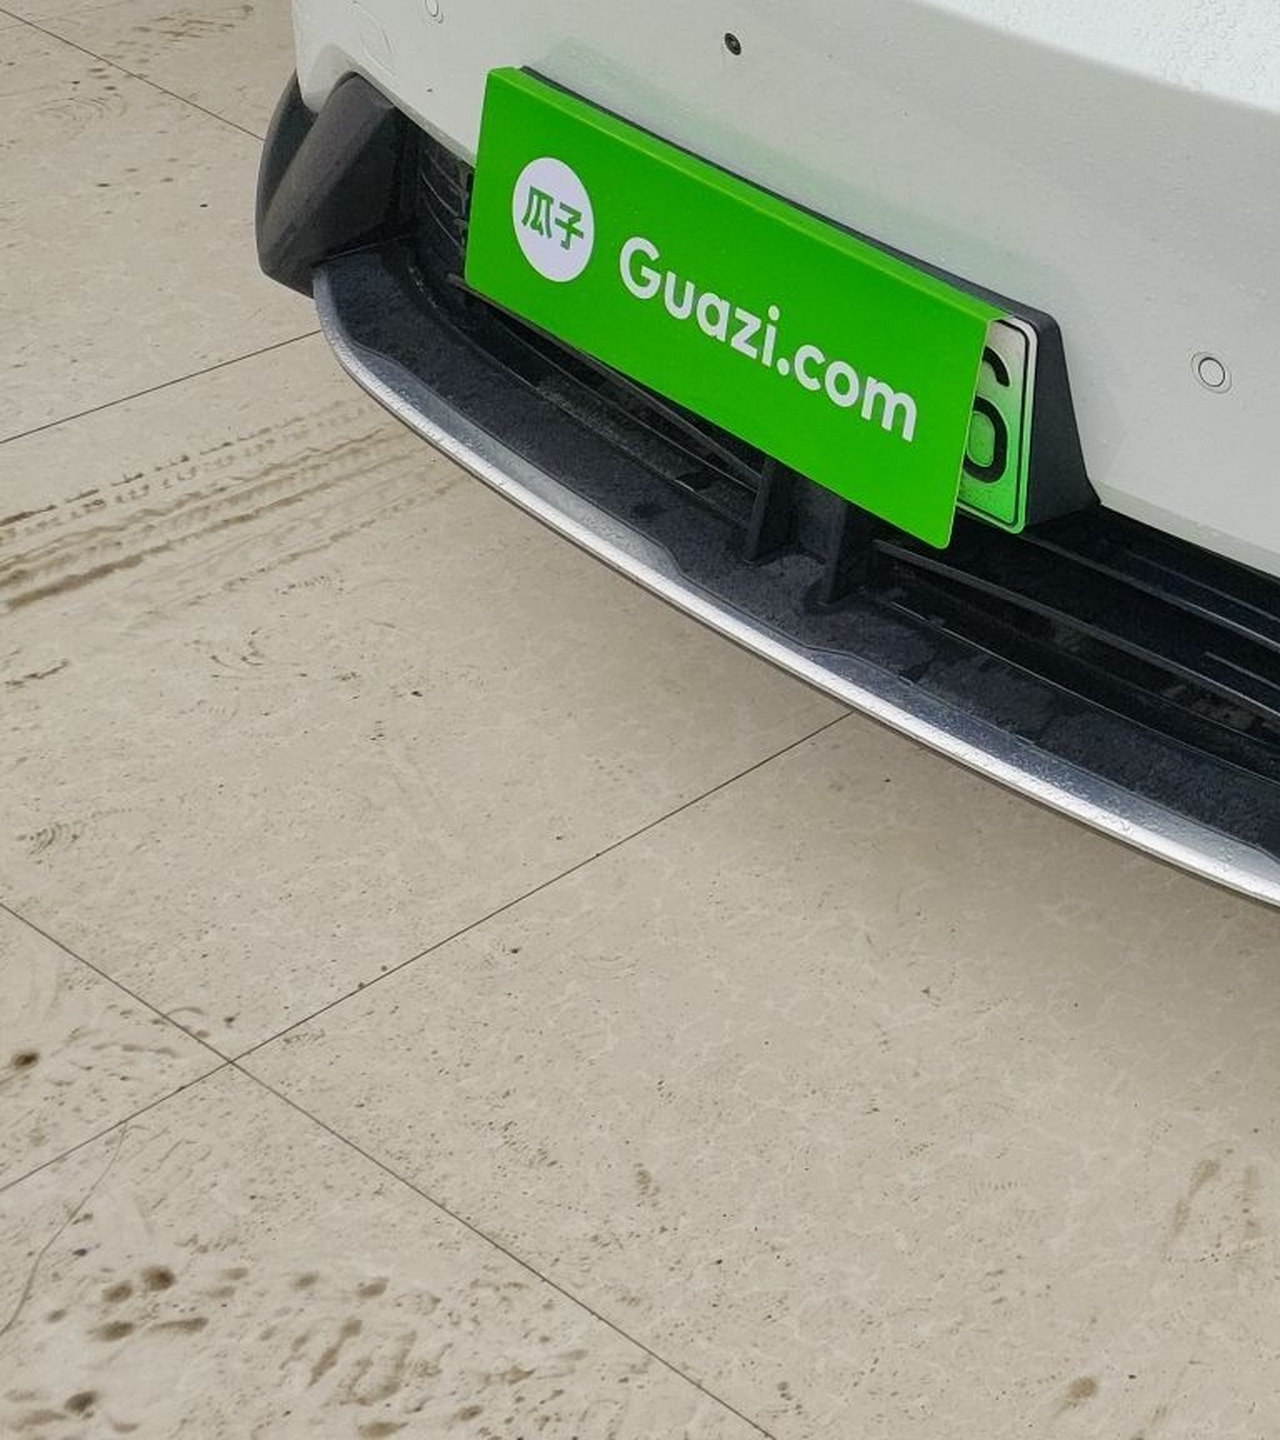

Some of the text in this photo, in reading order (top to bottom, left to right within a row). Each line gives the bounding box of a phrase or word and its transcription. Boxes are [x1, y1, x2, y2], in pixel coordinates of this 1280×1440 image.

[521, 185, 585, 251] 瓜子
[619, 236, 919, 444] Guazi.com
[963, 345, 1010, 484] 6
